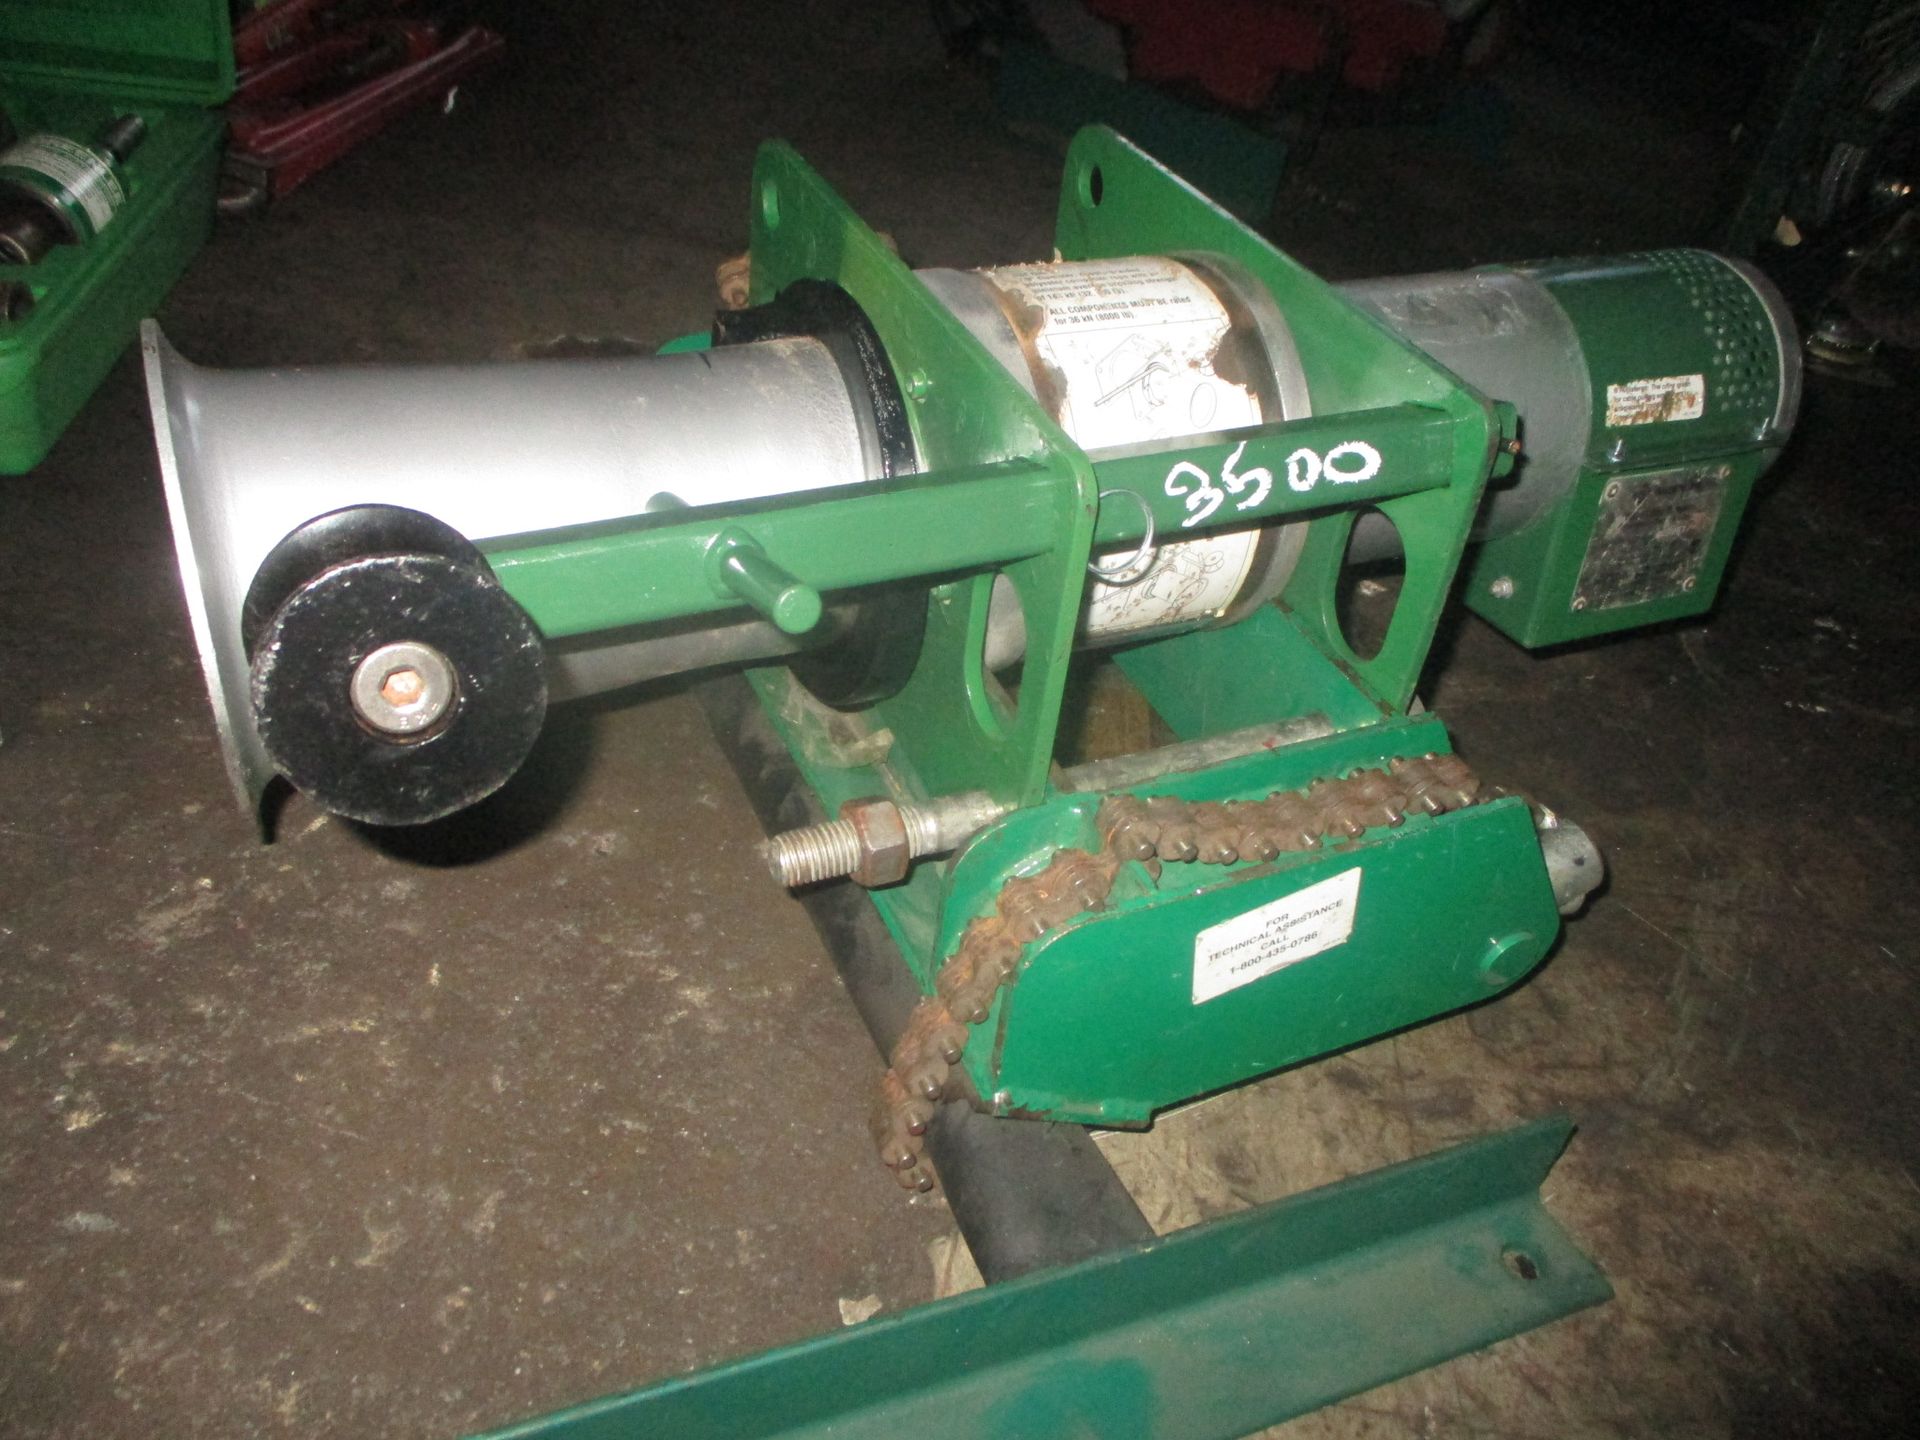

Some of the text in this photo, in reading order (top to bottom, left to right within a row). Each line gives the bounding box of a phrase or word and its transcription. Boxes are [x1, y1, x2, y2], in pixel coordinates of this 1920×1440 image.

[1049, 306, 1067, 316] ALL
[1068, 302, 1129, 314] COMPONENTS
[1054, 317, 1067, 326] for
[1068, 315, 1081, 324] 36
[1081, 314, 1094, 323] kN
[1095, 312, 1120, 323] (8000
[1164, 439, 1382, 528] 3500
[1265, 913, 1290, 928] FOR
[1208, 899, 1344, 962] TECHNICAL ASSISTANCE
[1260, 935, 1290, 951] CALL
[1229, 930, 1319, 975] 1-800-435-0786
